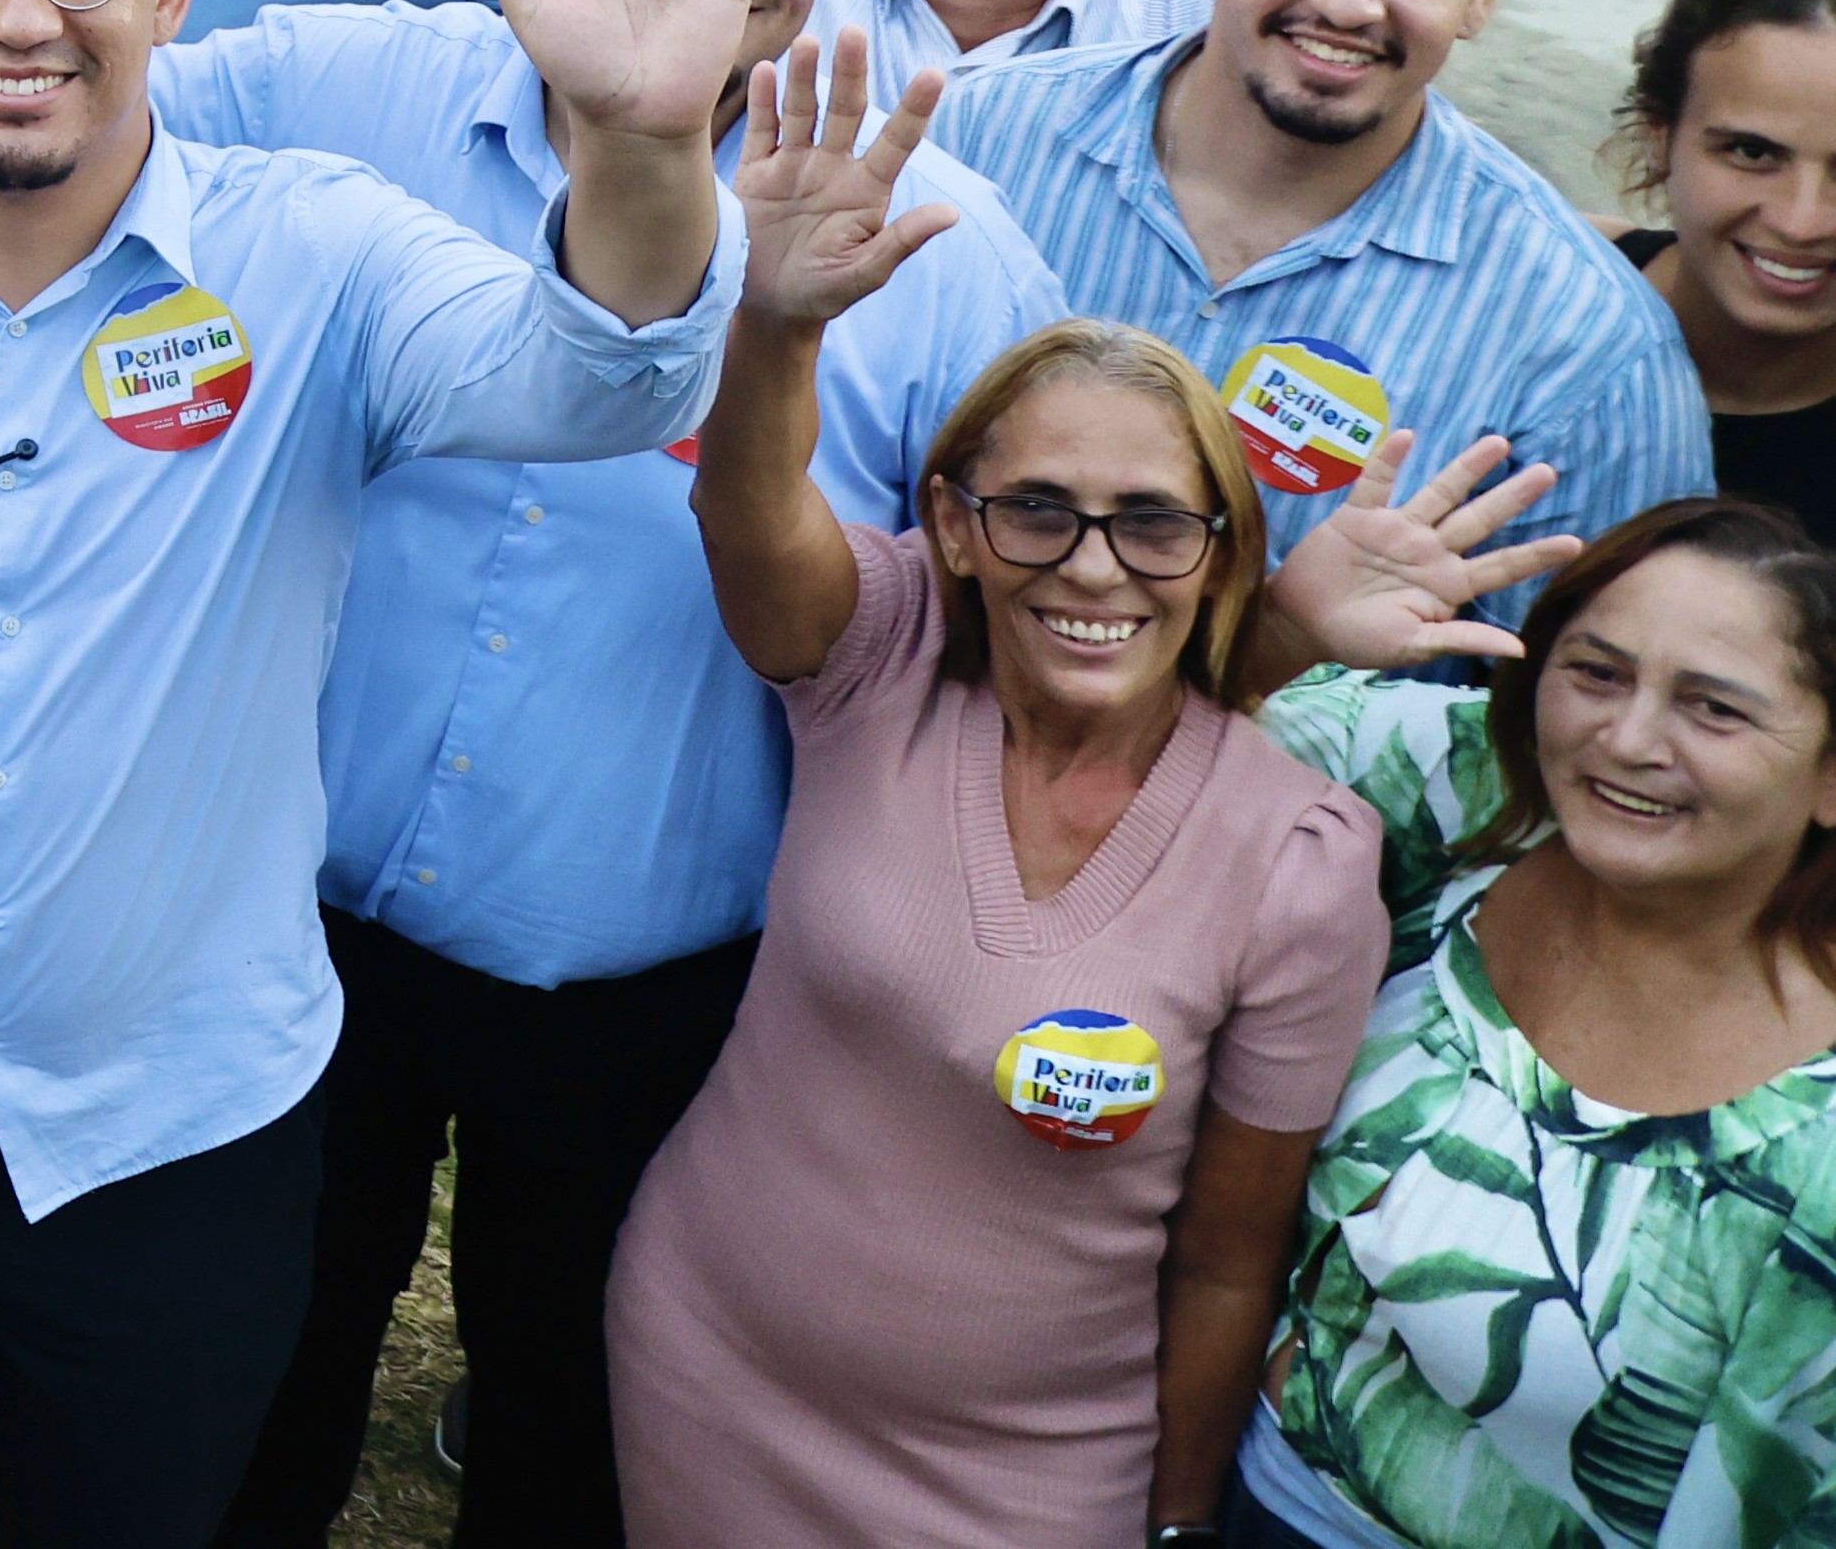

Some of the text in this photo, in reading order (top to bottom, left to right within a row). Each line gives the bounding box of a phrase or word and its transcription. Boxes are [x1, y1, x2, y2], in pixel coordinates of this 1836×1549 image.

[115, 327, 233, 373] Periferia
[121, 369, 181, 397] Viva
[179, 402, 232, 427] BRASIL
[1254, 388, 1307, 433] Viva
[1263, 369, 1373, 444] Periferia
[1034, 1057, 1150, 1092] Periferia
[1032, 1081, 1092, 1113] Viva
